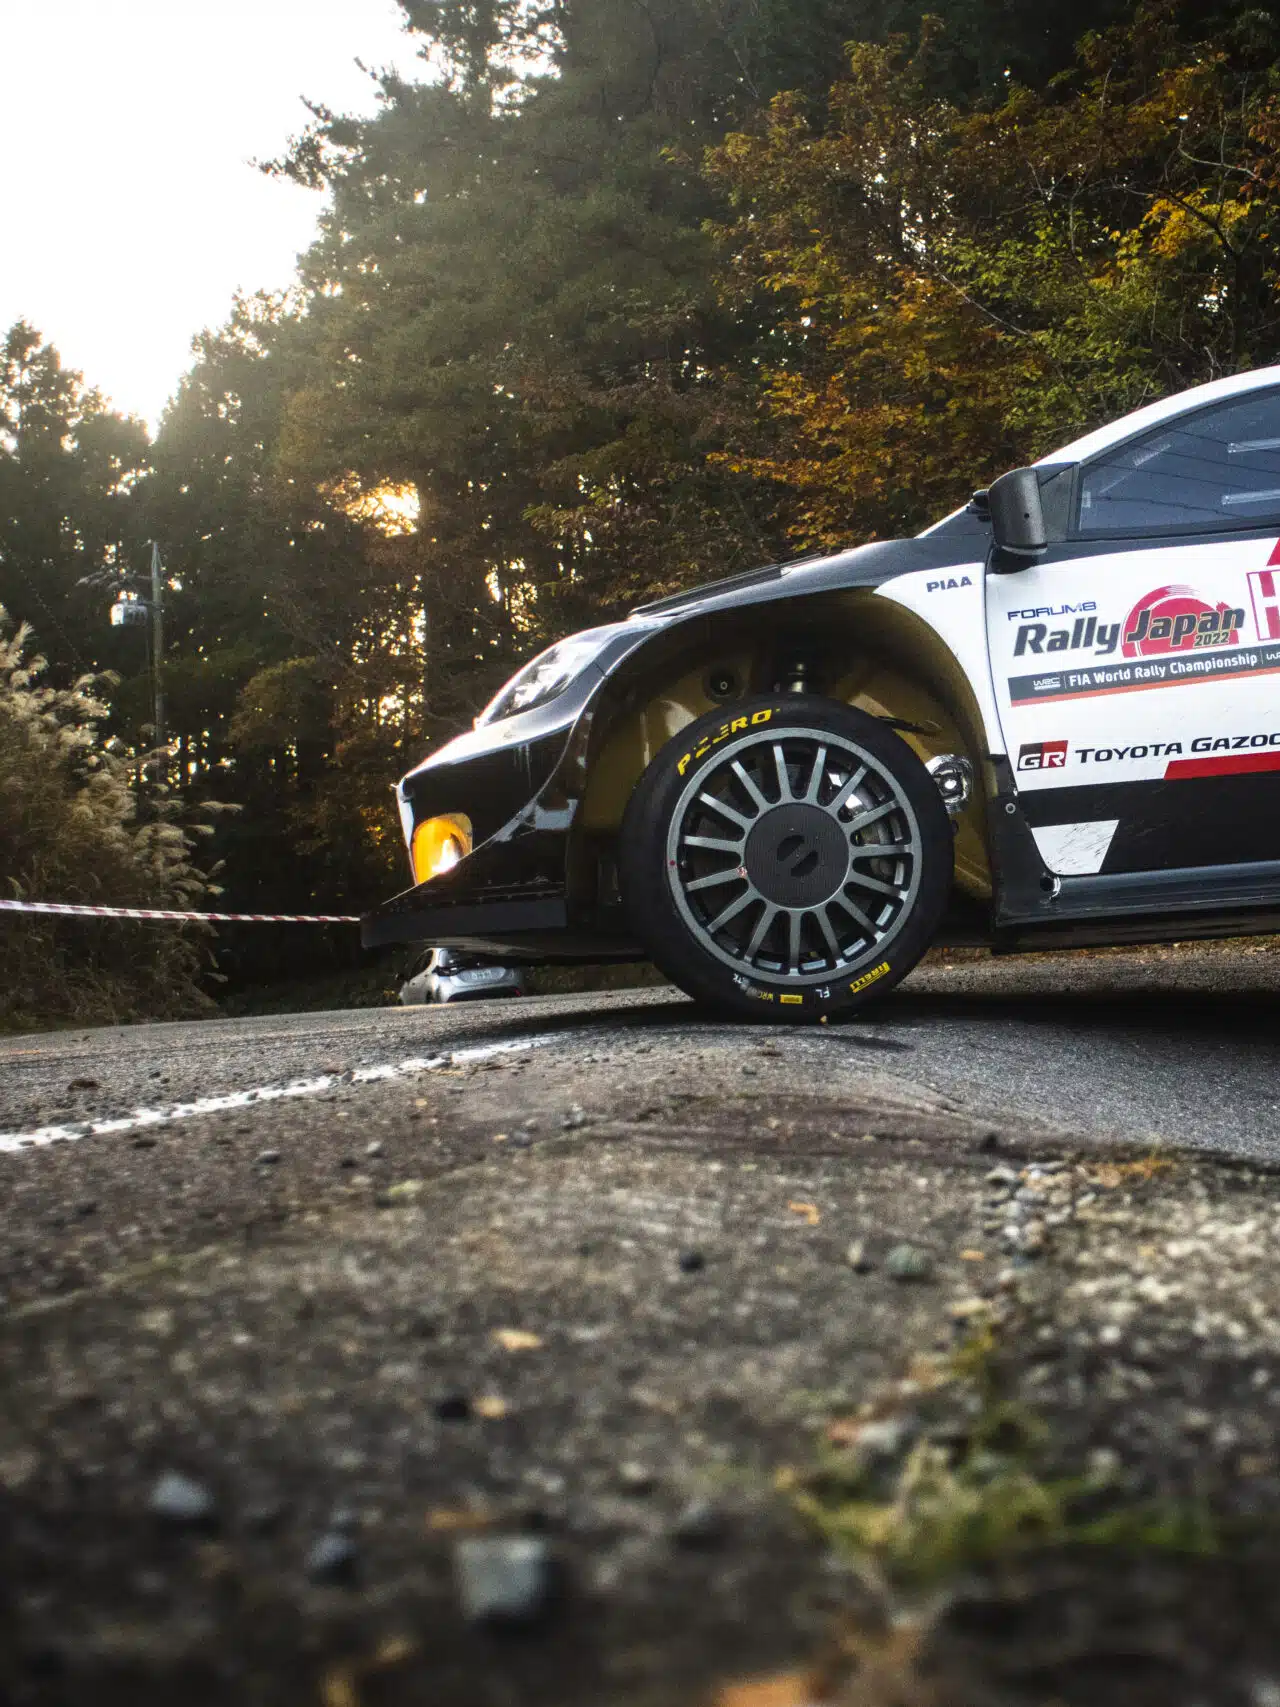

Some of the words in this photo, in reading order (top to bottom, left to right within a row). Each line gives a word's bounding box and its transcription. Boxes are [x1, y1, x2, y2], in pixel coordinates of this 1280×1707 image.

[926, 576, 973, 593] PIAA
[1013, 616, 1122, 657] Rally
[1126, 607, 1246, 648] Japan
[1193, 631, 1230, 648] 2022
[1069, 673, 1090, 687] FIA
[1094, 667, 1132, 684] World
[1135, 663, 1166, 679] Rally
[1170, 652, 1259, 675] Championship
[1018, 750, 1066, 771] GR
[1075, 742, 1182, 764] TOYOTA
